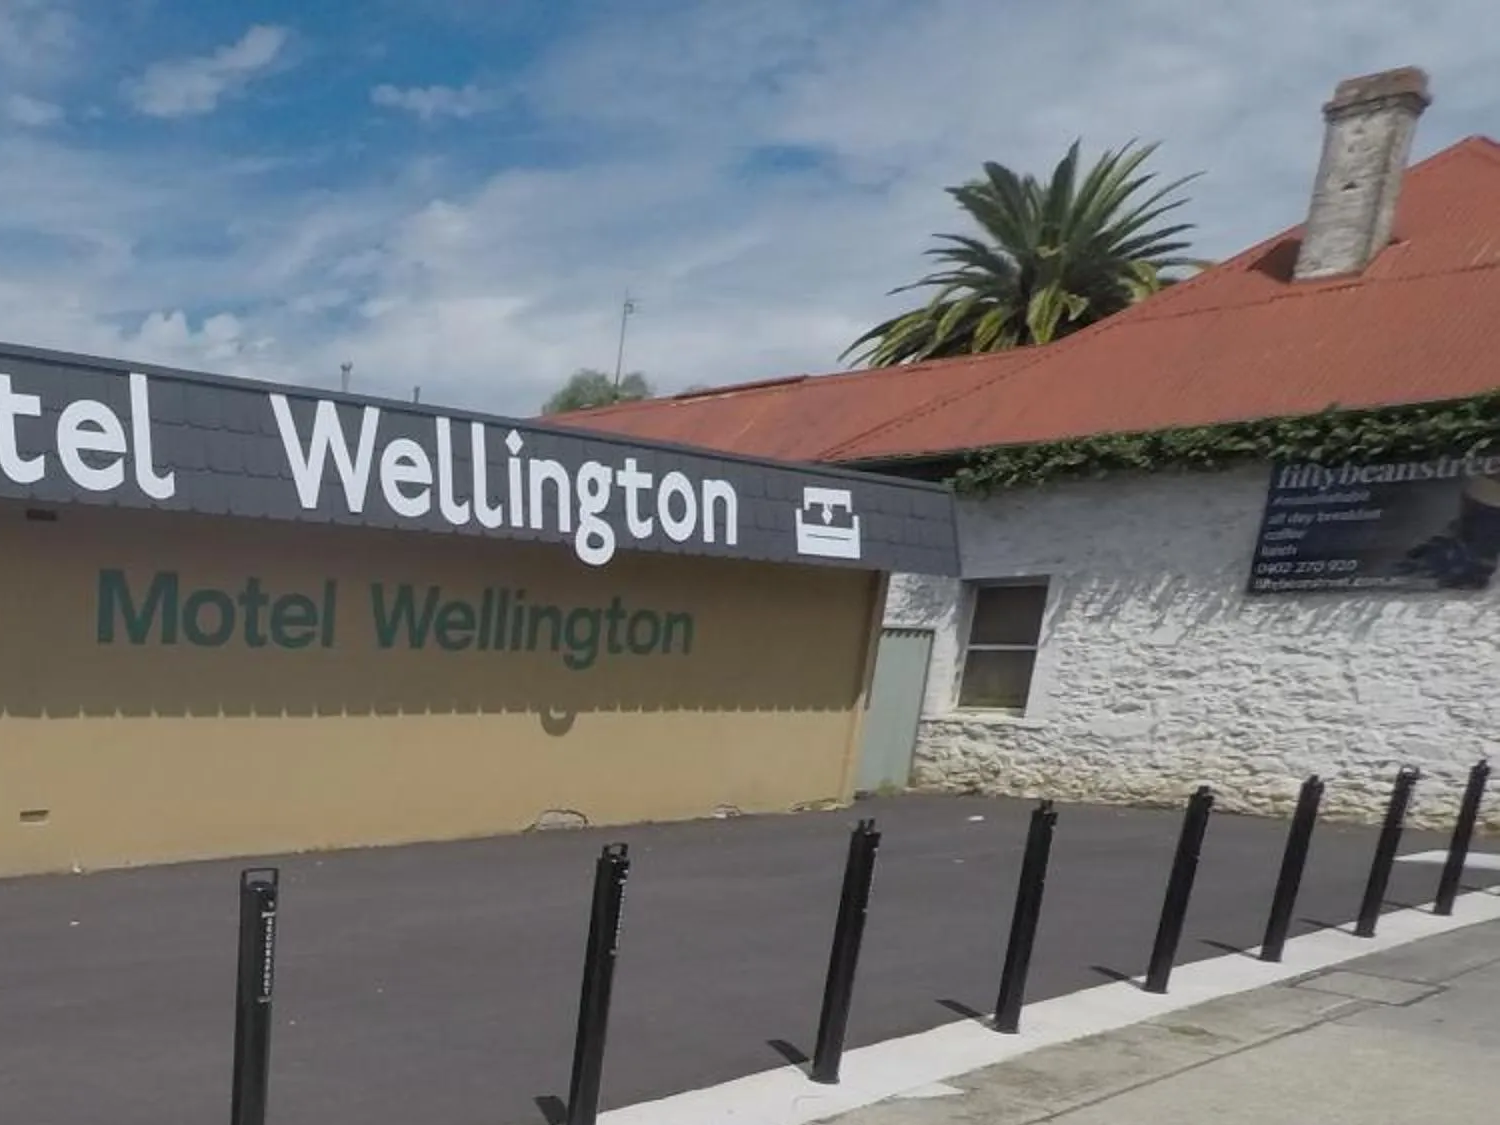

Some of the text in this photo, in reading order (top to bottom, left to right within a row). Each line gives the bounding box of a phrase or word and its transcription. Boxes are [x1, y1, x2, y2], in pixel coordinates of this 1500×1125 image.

[270, 392, 738, 566] Wellington
[96, 569, 694, 671] Motel Wellington
